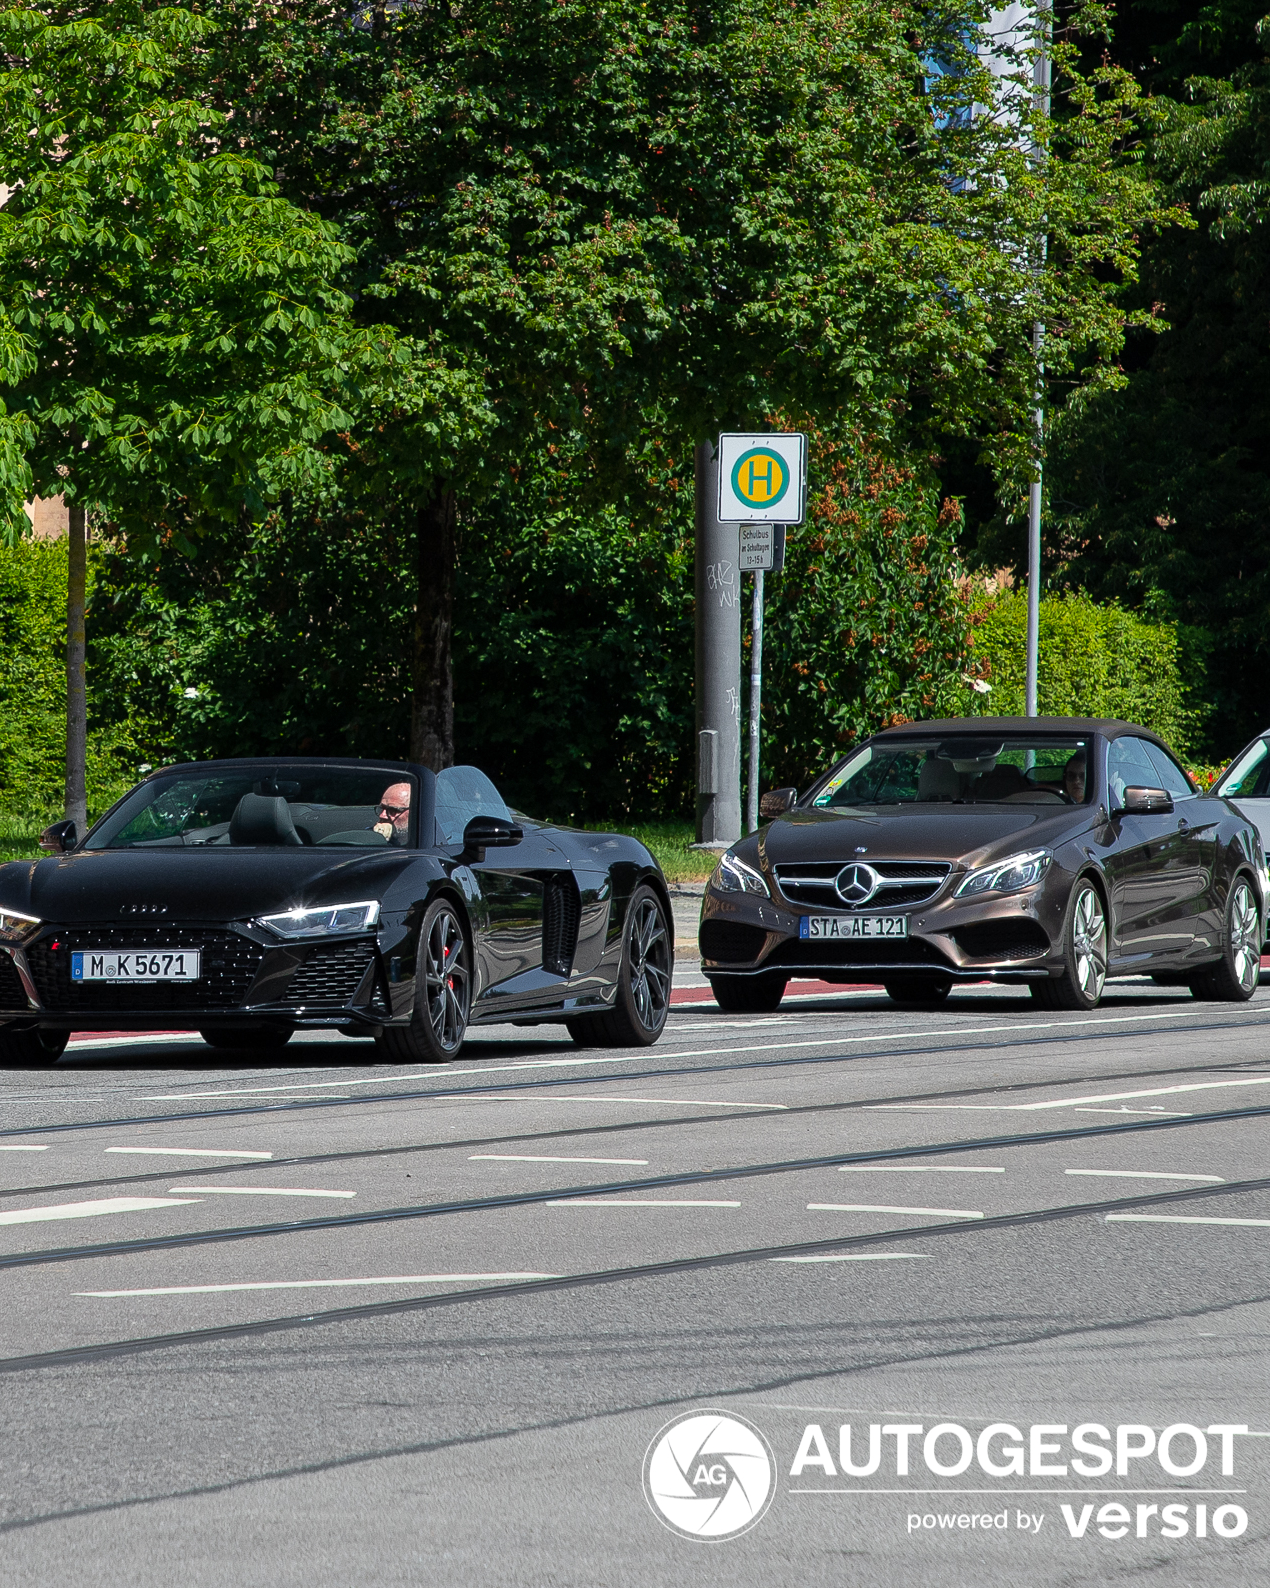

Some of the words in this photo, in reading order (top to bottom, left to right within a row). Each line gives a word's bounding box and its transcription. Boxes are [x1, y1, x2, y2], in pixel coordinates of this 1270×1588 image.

[748, 460, 773, 496] H
[742, 529, 769, 540] Schulbus
[810, 918, 840, 936] STA
[852, 917, 872, 936] AE
[876, 917, 905, 935] 121
[75, 968, 81, 976] D
[91, 955, 104, 976] M
[117, 955, 132, 976] K
[135, 954, 187, 976] 5671
